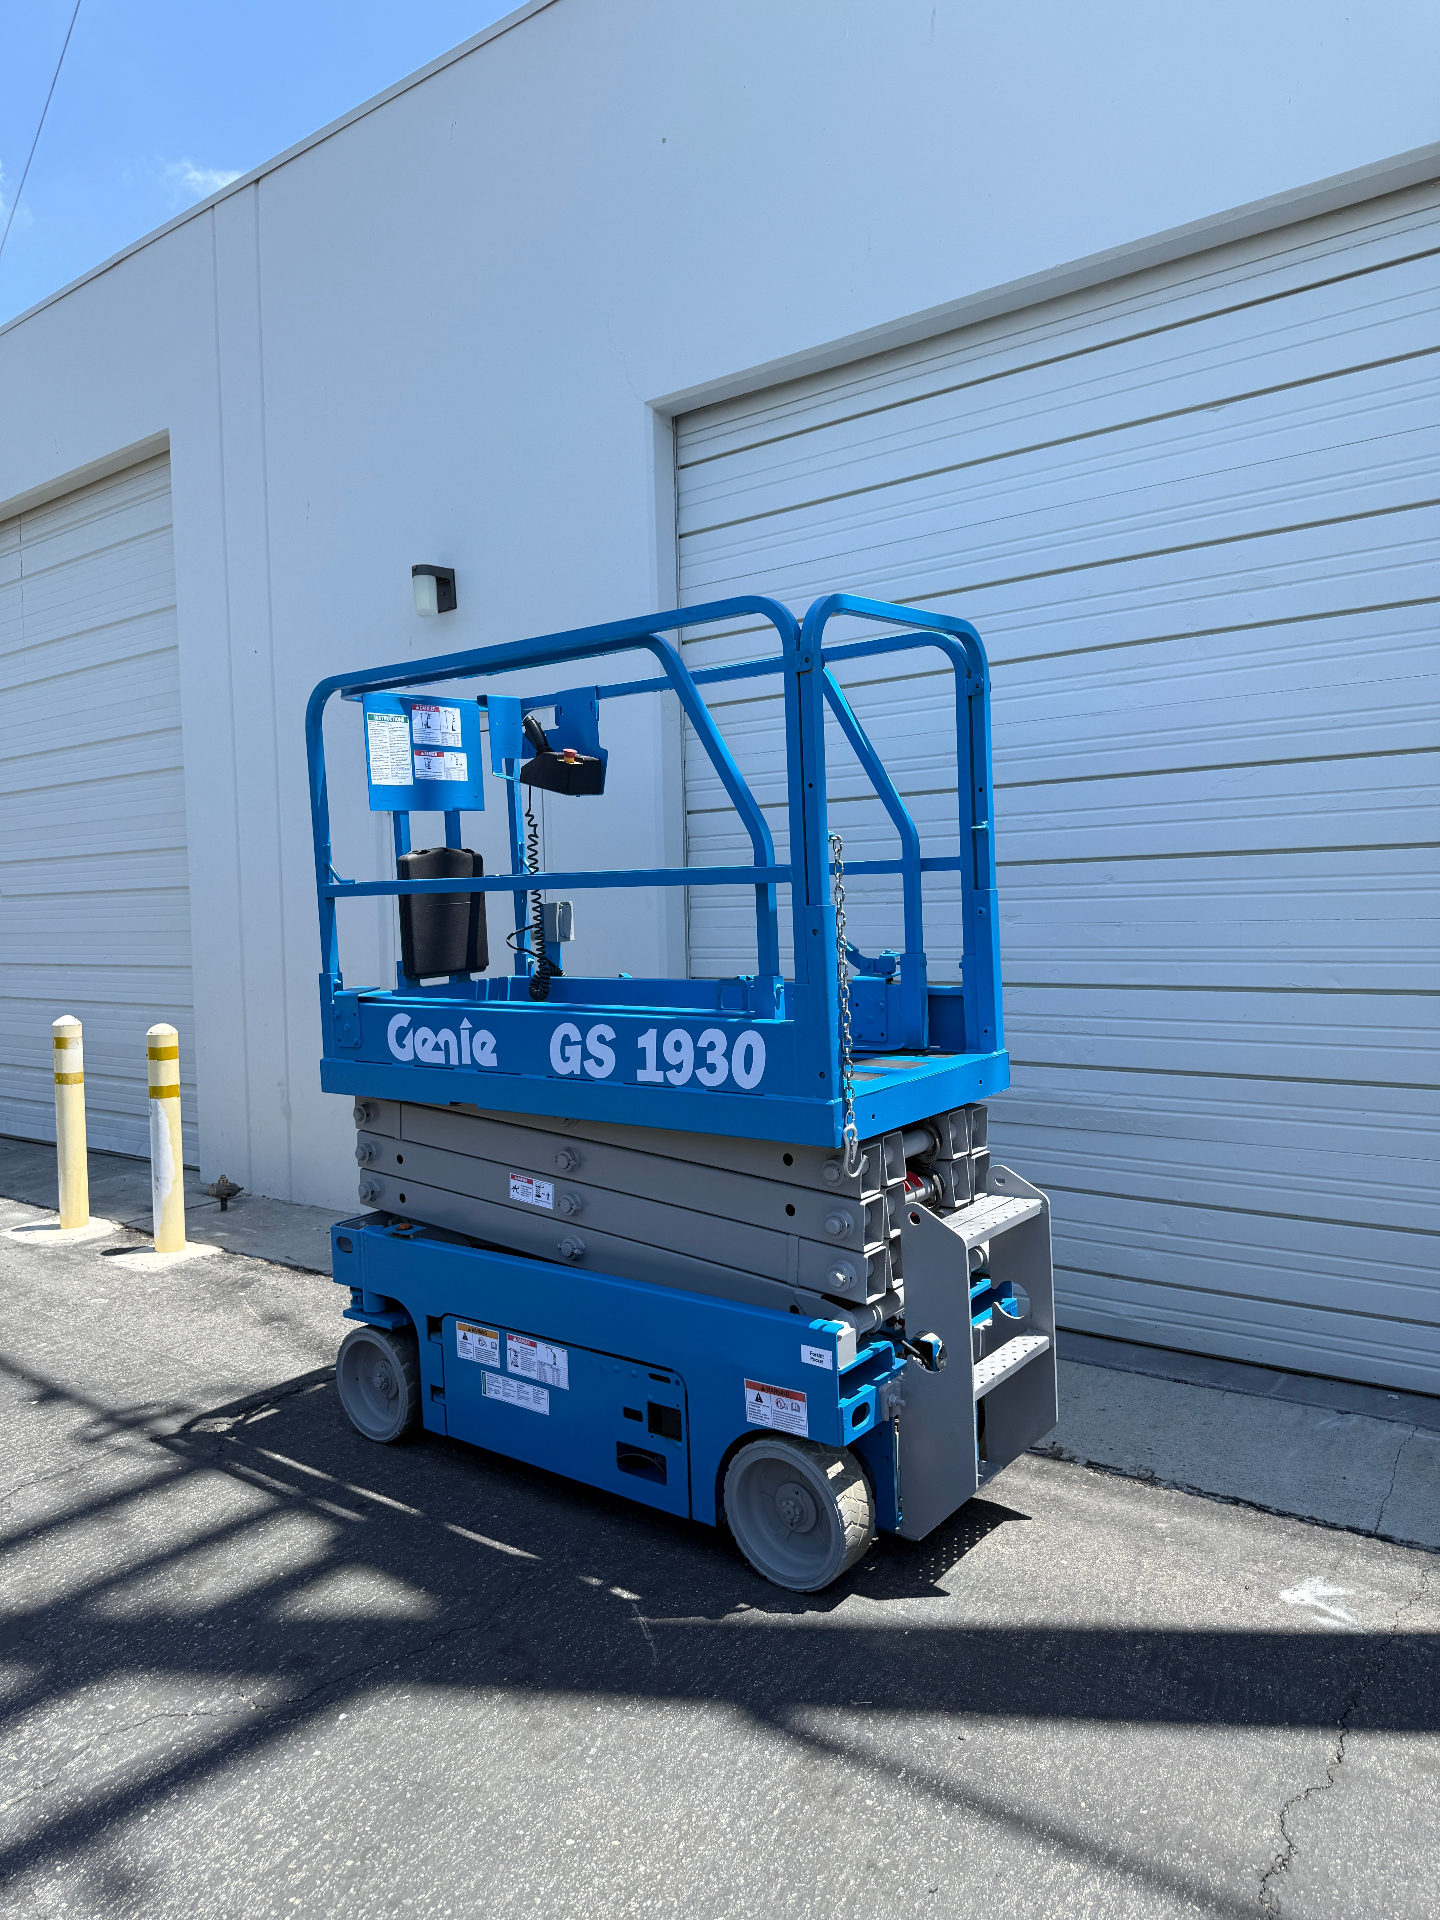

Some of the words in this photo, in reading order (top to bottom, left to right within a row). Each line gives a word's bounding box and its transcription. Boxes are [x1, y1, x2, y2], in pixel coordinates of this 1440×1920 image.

[387, 1012, 498, 1067] Genie
[549, 1022, 616, 1079] GS
[636, 1027, 766, 1089] 1930
